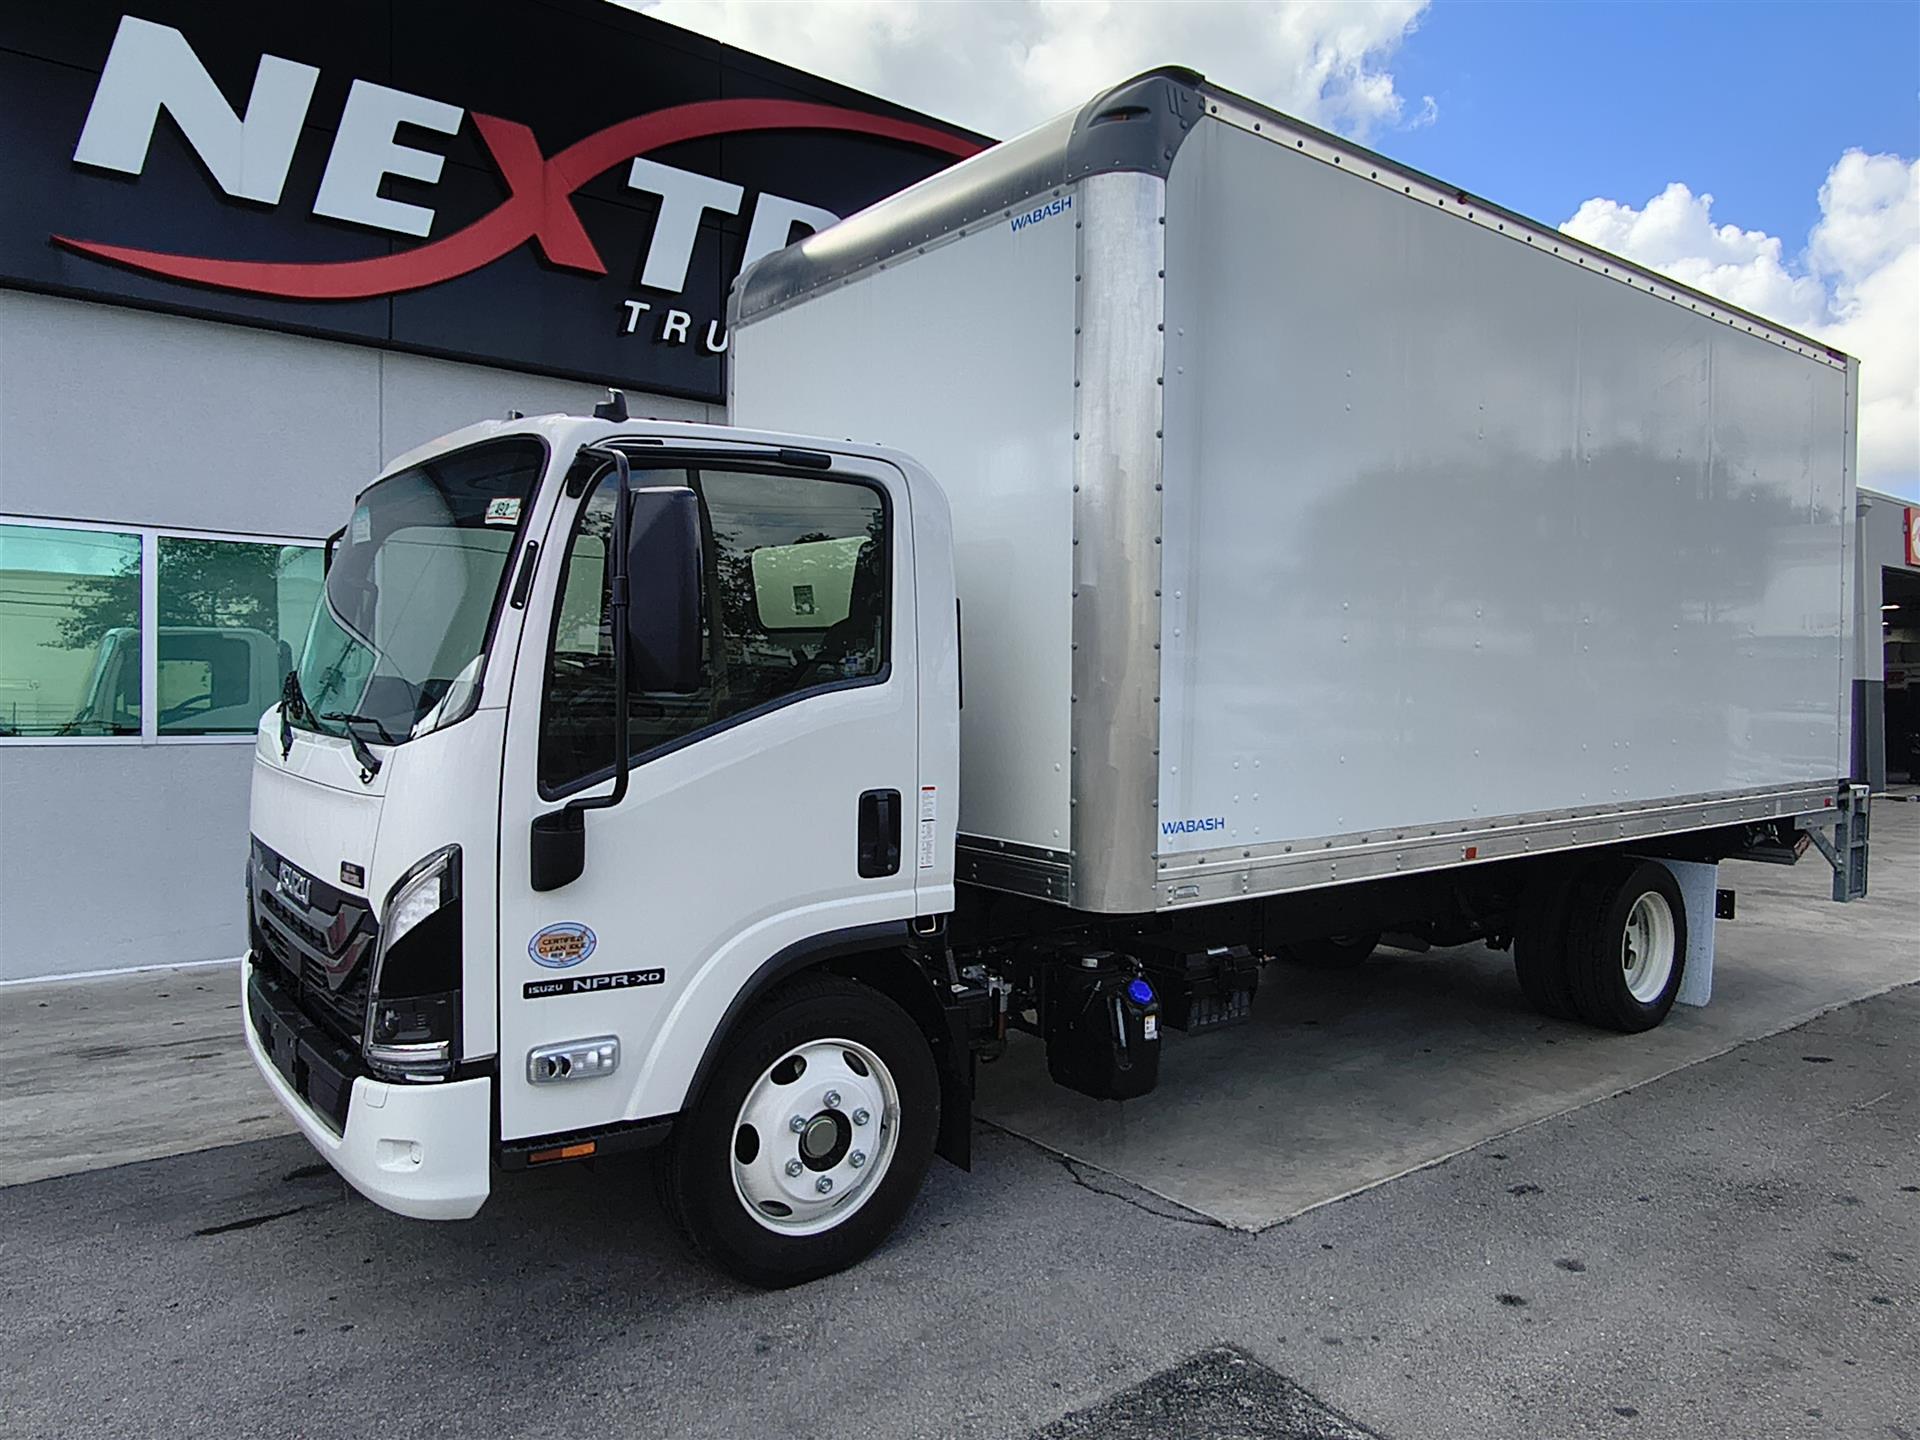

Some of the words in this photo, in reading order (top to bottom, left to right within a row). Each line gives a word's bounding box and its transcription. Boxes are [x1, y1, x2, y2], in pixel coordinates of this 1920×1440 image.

[1010, 196, 1072, 232] WABASH
[1161, 817, 1225, 834] WABASH
[539, 944, 567, 953] CLEAN
[528, 983, 564, 995] ISUZU
[573, 972, 661, 991] NPR-XD
